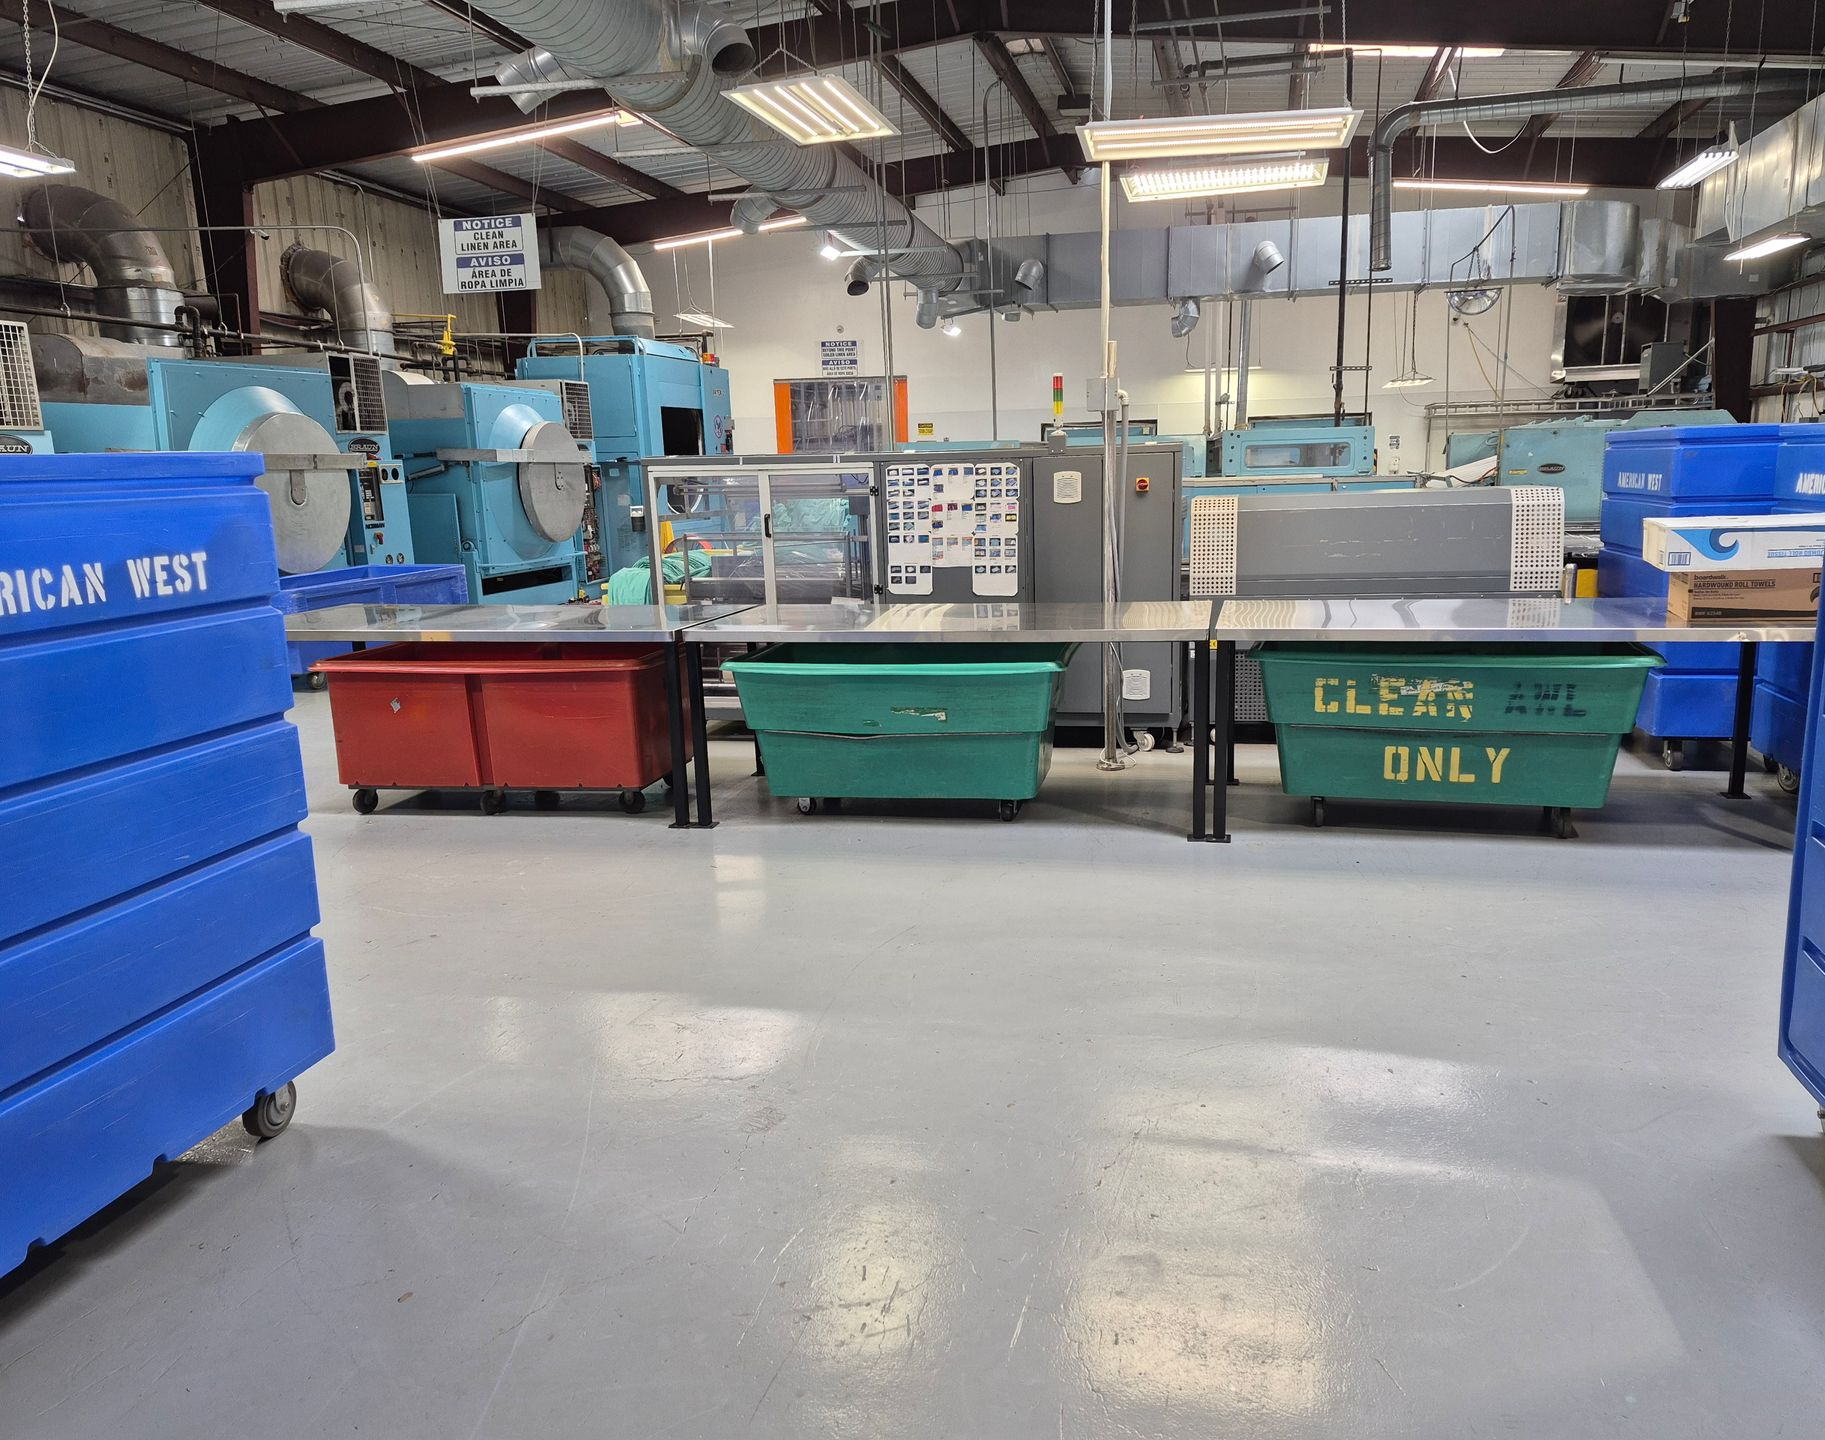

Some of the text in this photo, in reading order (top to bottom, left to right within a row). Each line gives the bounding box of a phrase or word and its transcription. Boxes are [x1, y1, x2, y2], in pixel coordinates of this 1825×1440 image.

[462, 218, 513, 231] NOTICE
[473, 230, 504, 241] CLEAN
[461, 240, 518, 252] LINEN AREA
[470, 256, 511, 267] AVISO
[471, 268, 512, 279] ÁREA DE
[460, 278, 524, 290] ROPA LIMPIA
[1617, 472, 1663, 491] AMERICAN WEST
[126, 551, 208, 599] WEST
[1750, 580, 1776, 588] TOWELS
[1314, 676, 1474, 719] CLEAN
[1383, 746, 1511, 784] ONLY
